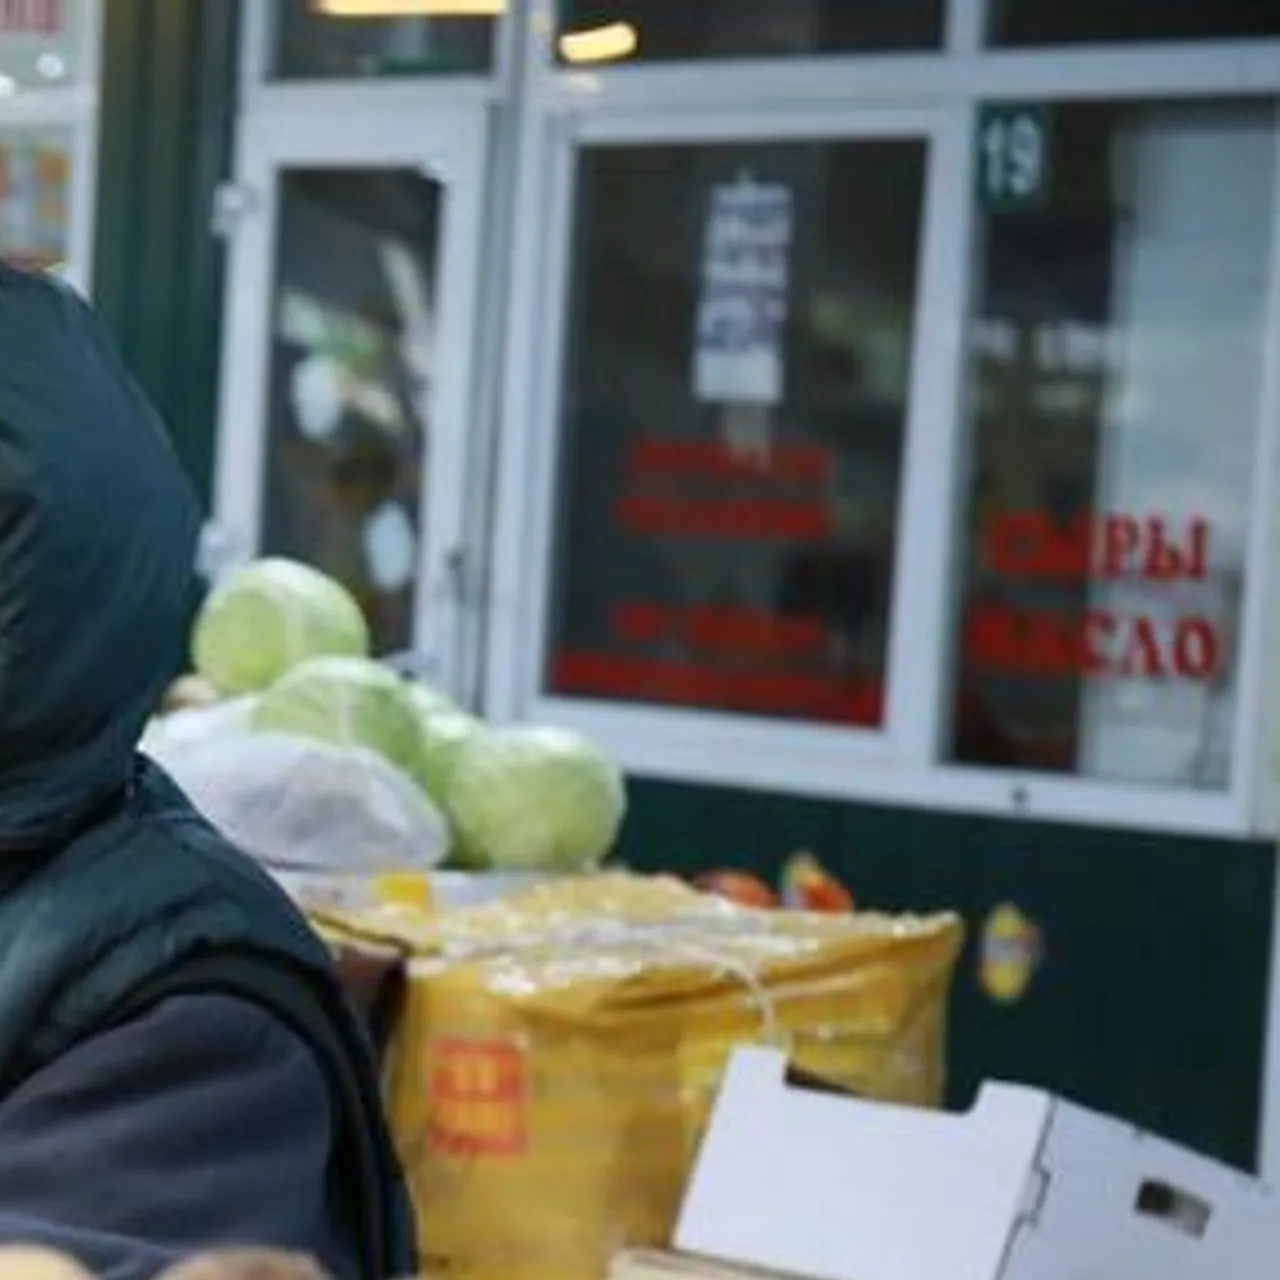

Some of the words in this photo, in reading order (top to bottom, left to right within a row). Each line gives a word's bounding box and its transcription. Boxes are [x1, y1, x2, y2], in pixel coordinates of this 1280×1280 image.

[984, 114, 1042, 197] 19
[990, 510, 1208, 580] СЫРЫ
[970, 602, 1220, 680] МАСЛО
